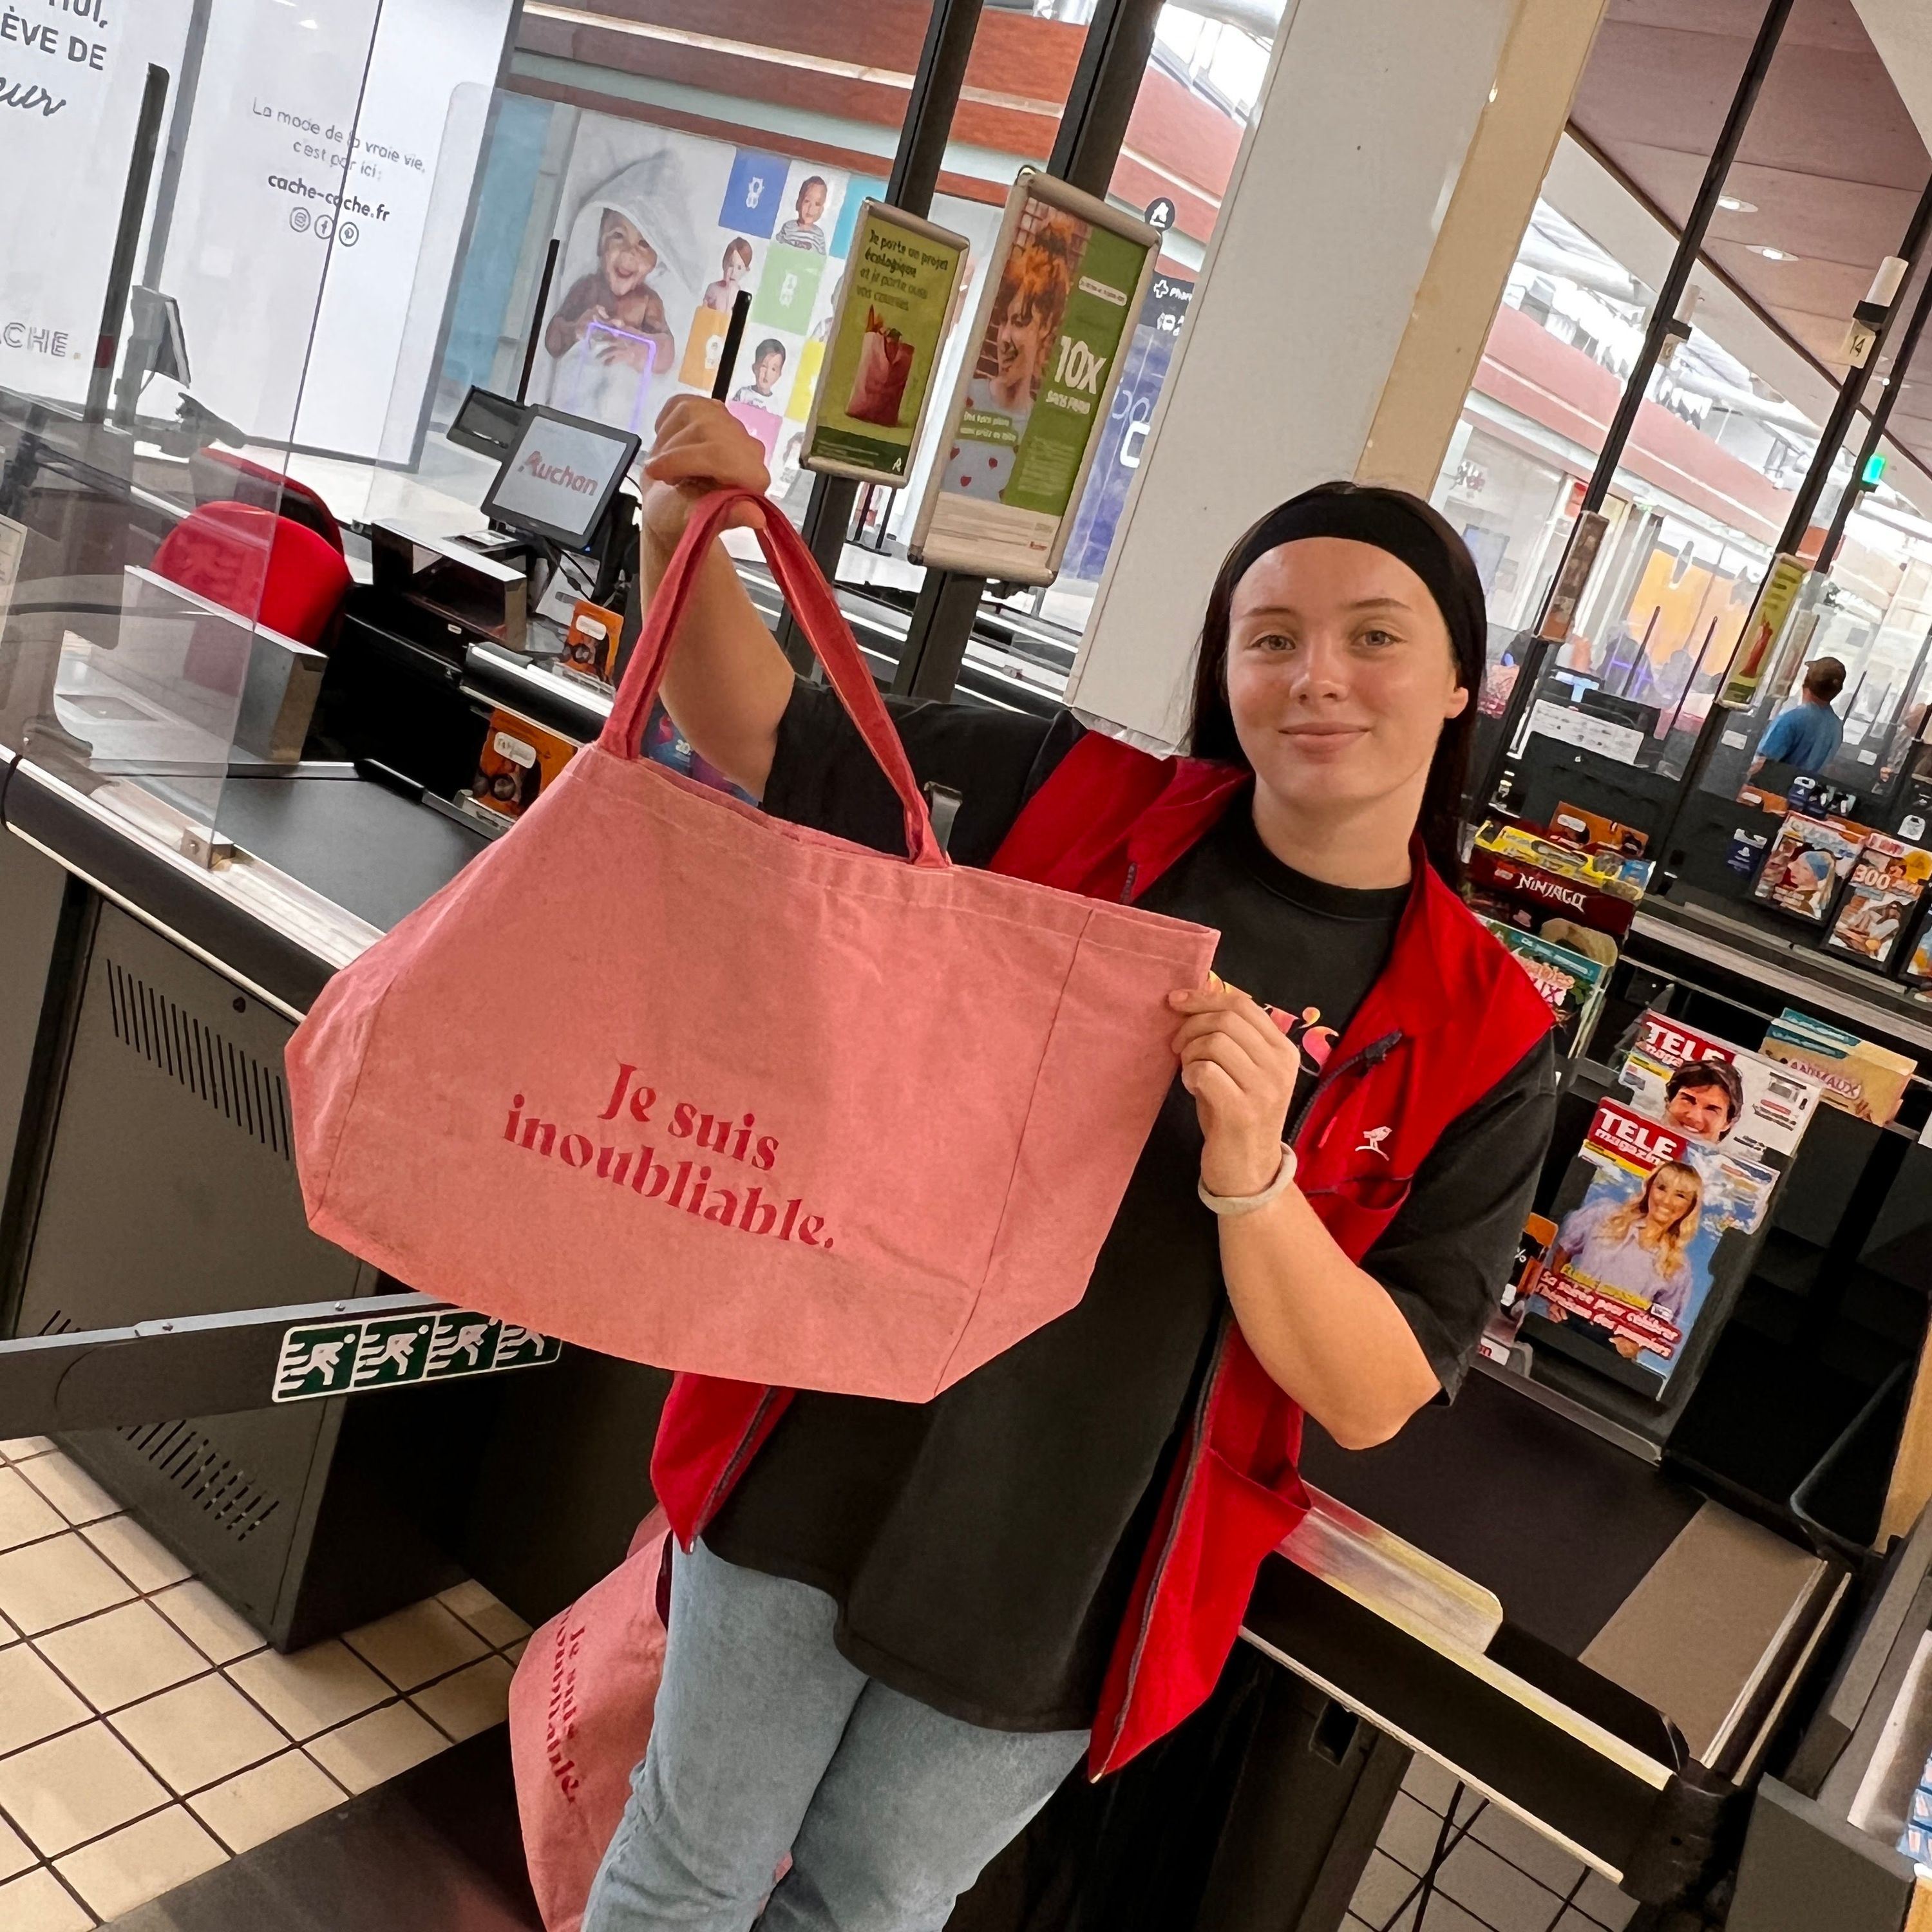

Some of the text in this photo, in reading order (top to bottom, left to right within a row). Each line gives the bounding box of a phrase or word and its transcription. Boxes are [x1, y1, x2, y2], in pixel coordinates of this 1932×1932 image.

[68, 35, 107, 71] DE
[278, 111, 320, 135] mode
[325, 125, 343, 143] de
[365, 141, 400, 162] vraie
[268, 175, 390, 222] cache-cache.fr
[1054, 335, 1107, 395] 10X
[1850, 335, 1866, 357] 14
[518, 450, 598, 496] Auchan
[1515, 872, 1587, 914] NINJAGO
[596, 1062, 779, 1171] Je suis
[1599, 1108, 1678, 1161] TELE
[503, 1094, 834, 1249] inoubliable.
